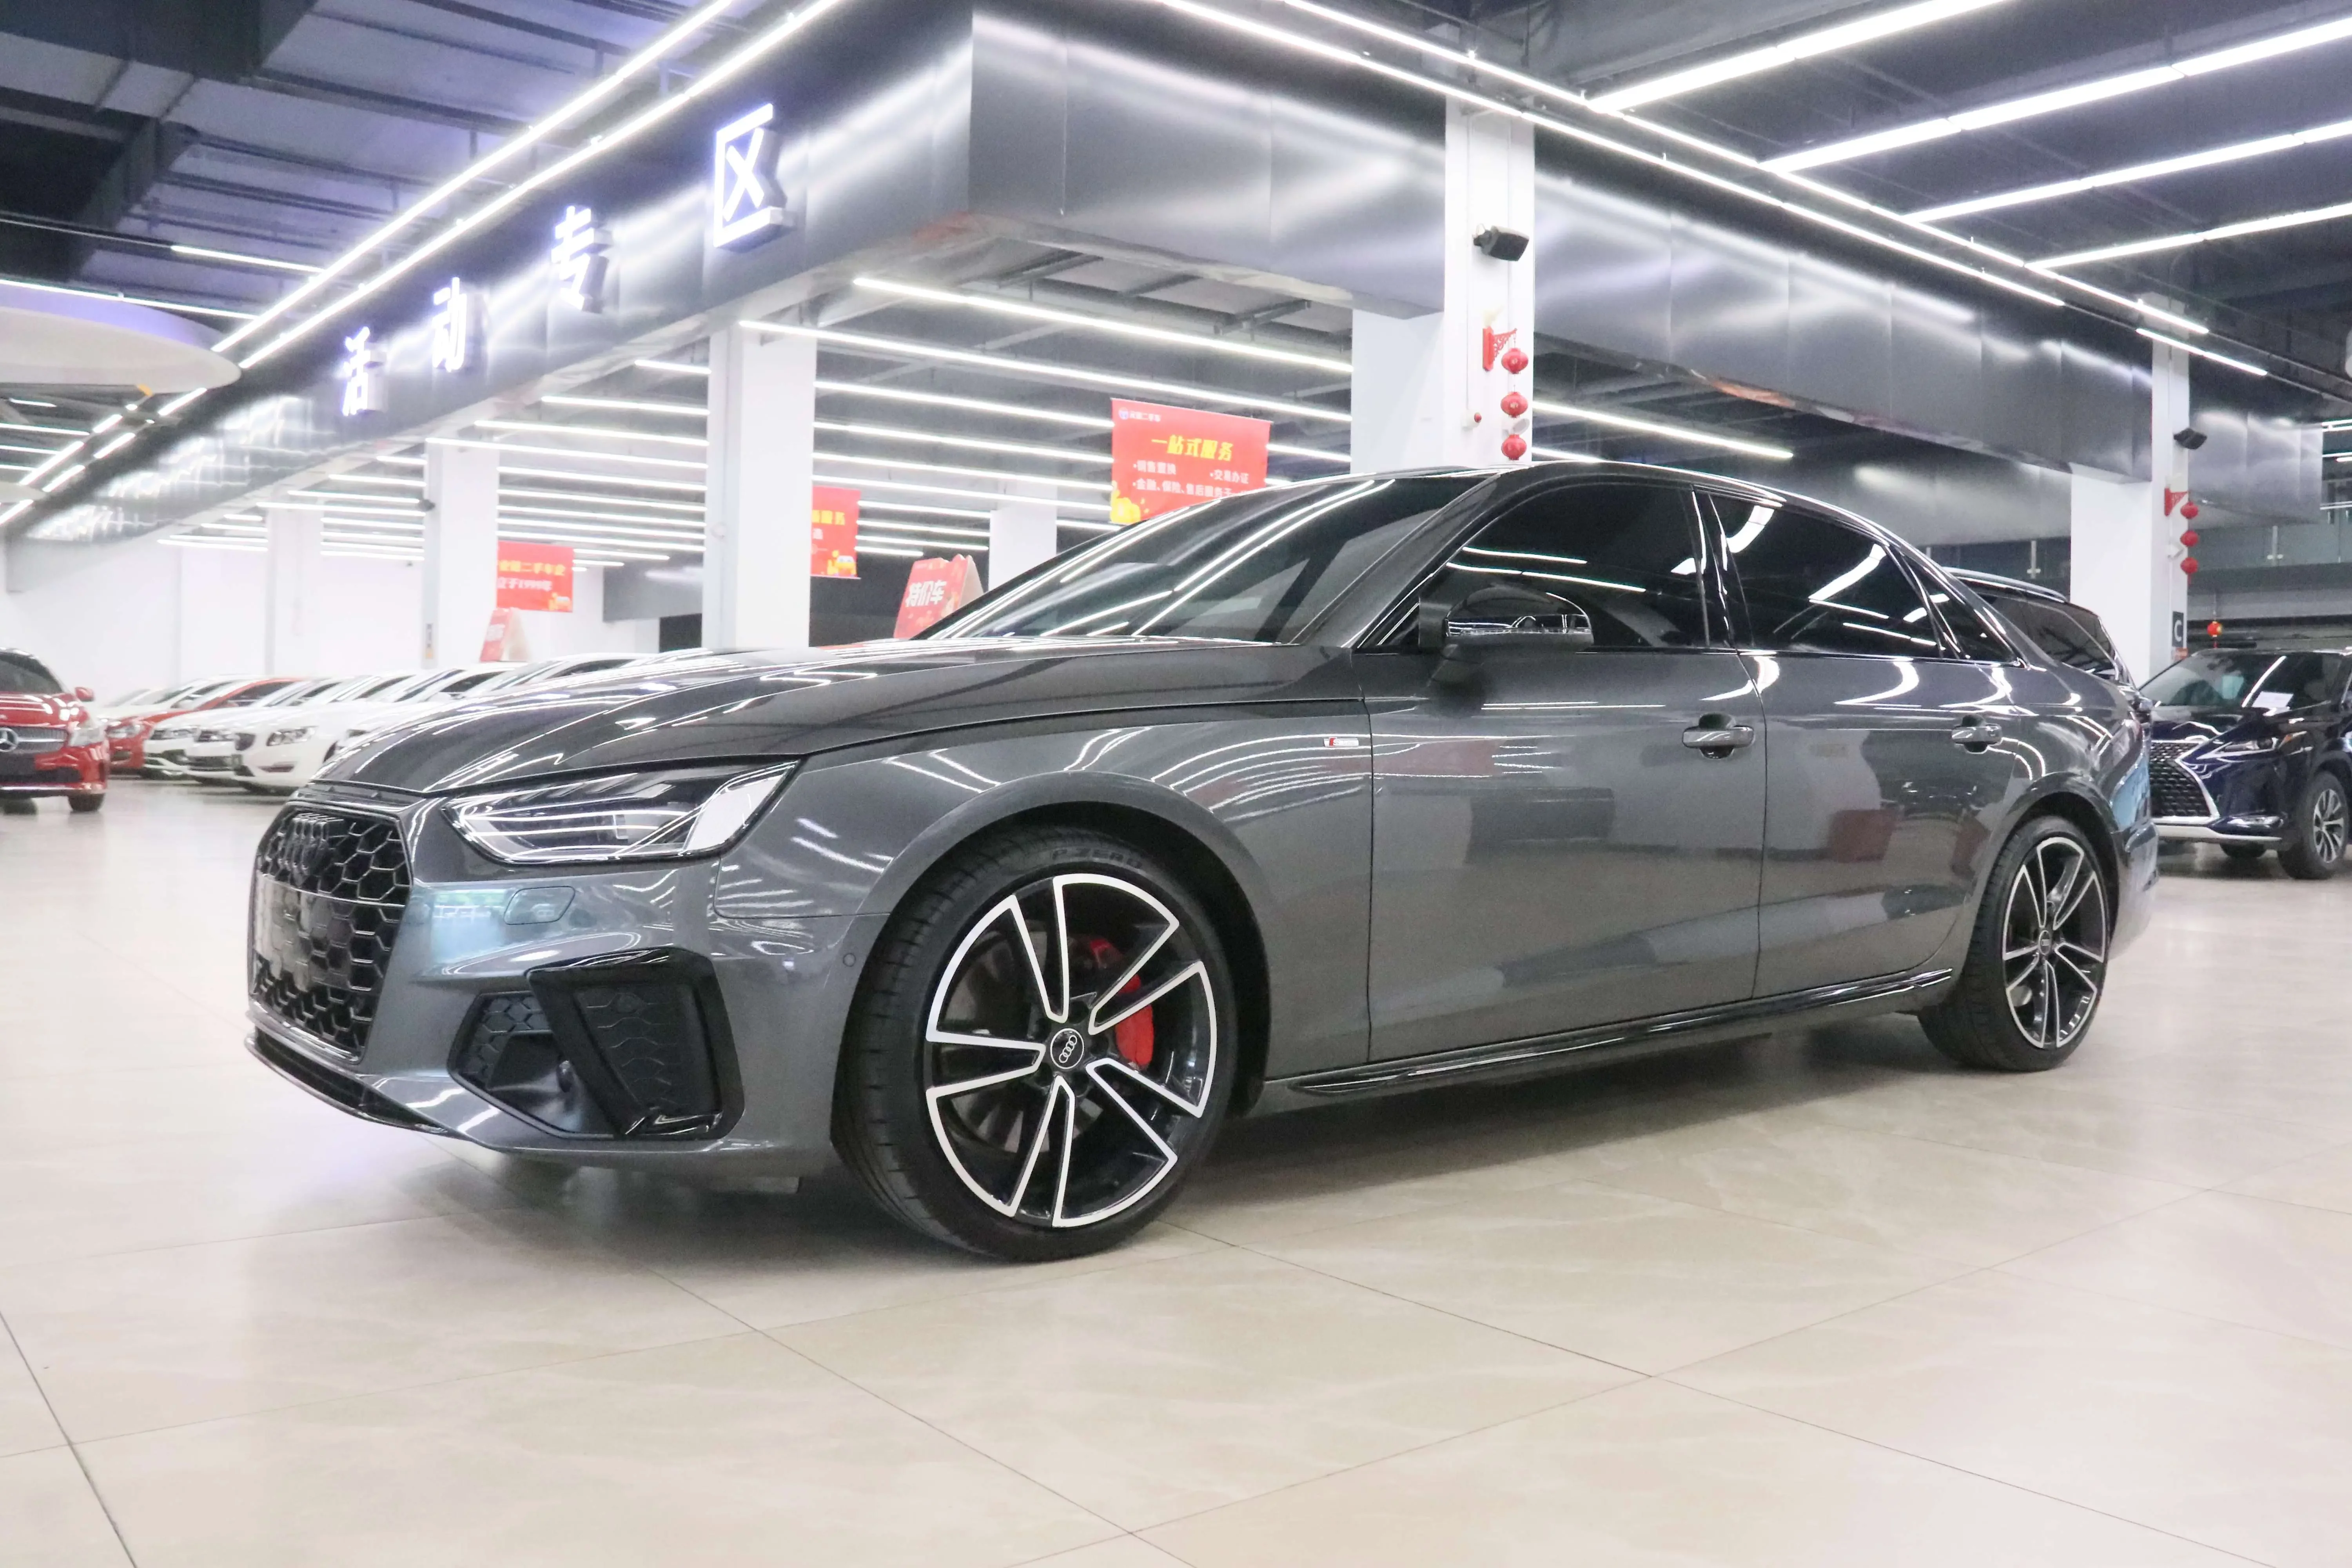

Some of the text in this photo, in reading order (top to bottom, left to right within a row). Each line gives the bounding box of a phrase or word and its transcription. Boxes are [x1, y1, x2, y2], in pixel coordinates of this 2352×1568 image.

[341, 102, 783, 416] 活动专区
[1151, 434, 1233, 461] 一站式服务
[1214, 469, 1249, 484] 交易办证
[906, 580, 947, 607] 特价车
[2174, 620, 2182, 642] C
